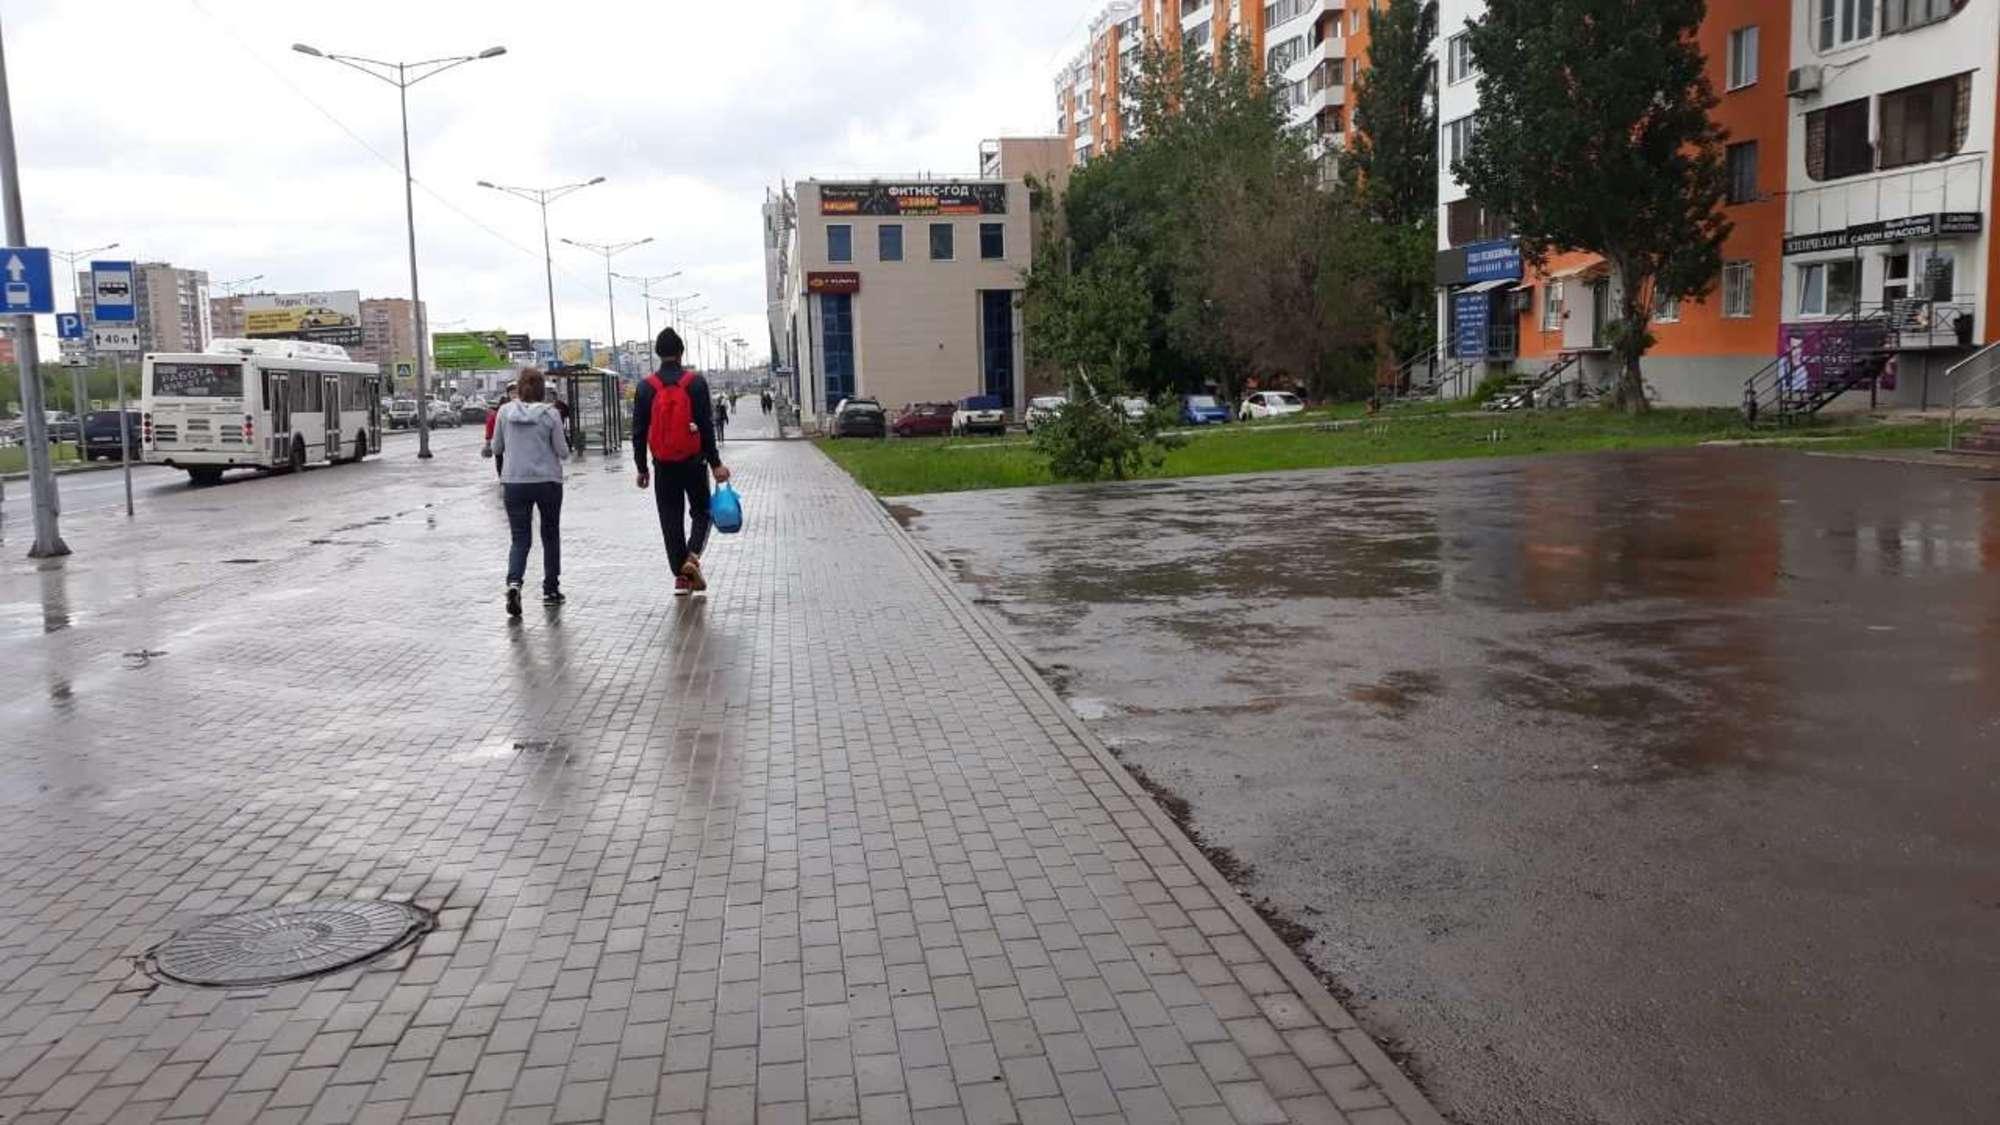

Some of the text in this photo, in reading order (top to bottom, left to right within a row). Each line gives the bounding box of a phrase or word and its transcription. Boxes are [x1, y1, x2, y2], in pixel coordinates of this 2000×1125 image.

[888, 185, 970, 197] ФИТНЕС-ГОД
[1850, 233, 1882, 244] САЛОН
[1883, 226, 1931, 240] КРАСОТЫ
